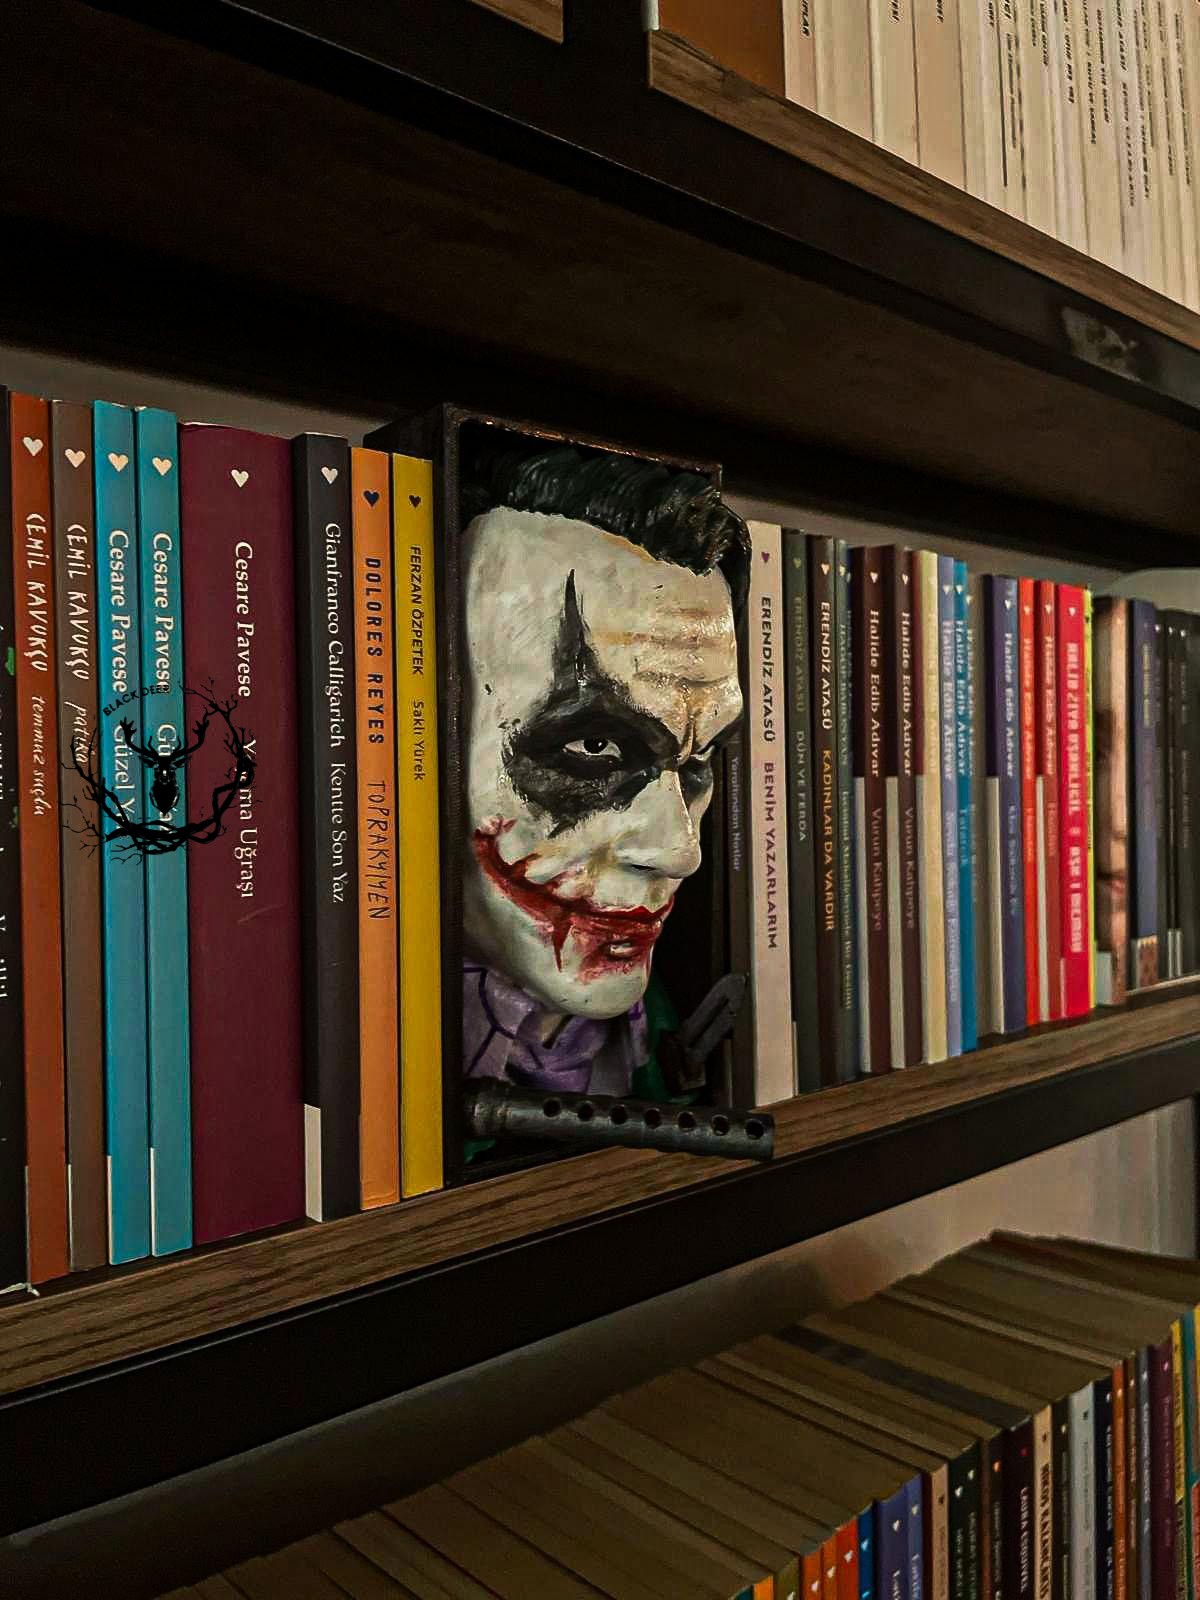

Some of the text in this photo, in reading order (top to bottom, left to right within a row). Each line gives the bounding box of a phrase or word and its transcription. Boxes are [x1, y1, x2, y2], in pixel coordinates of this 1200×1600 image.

[25, 513, 49, 569] CEMİL
[66, 524, 91, 579] CEMİL
[109, 530, 129, 607] Cesare
[153, 533, 173, 609] Cesare
[235, 542, 253, 615] Cesare
[365, 557, 384, 657] DOLORES
[24, 581, 49, 672] KAVUKÇU
[65, 591, 90, 680] KAVUKÇU
[111, 613, 131, 693] Pavese
[236, 622, 254, 698] Pavese
[410, 545, 425, 781] FERZAN ÖZPETEK Saklı Yürek
[870, 609, 880, 668] Halide
[901, 612, 911, 669] Halide
[325, 523, 348, 903] Gianfranco Calligarich Kentte Son Yaz
[367, 673, 385, 744] REYES
[871, 674, 881, 712] Edib
[902, 675, 912, 713] Edib
[31, 696, 46, 765] temmuz
[821, 602, 835, 931] ERENDİZ ATASÜ KADINLAR DA VARDIR
[871, 718, 881, 777] Adıvar
[903, 718, 913, 777] Adıvar
[761, 596, 777, 949] ERENDİZ ATASÜ BENİM YAZARLARIM
[234, 828, 258, 897] Uğraşı
